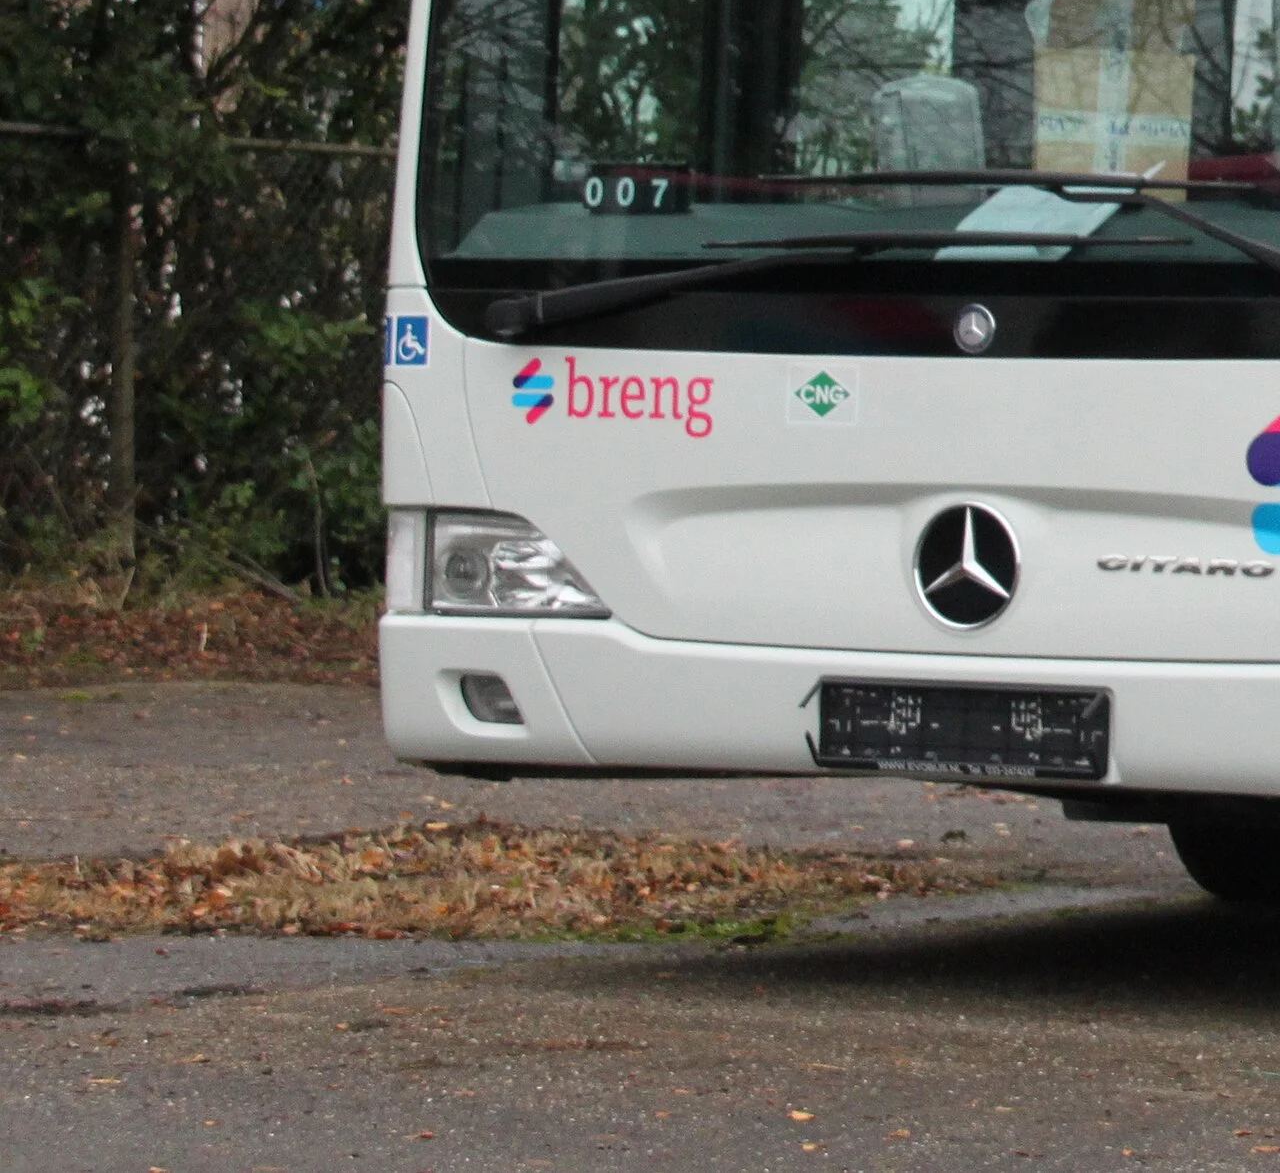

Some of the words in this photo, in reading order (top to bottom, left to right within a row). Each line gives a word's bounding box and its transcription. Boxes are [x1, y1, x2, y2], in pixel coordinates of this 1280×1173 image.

[585, 176, 669, 208] 007
[564, 355, 714, 439] breng
[801, 384, 846, 405] CNG
[1096, 554, 1276, 579] CITARO
